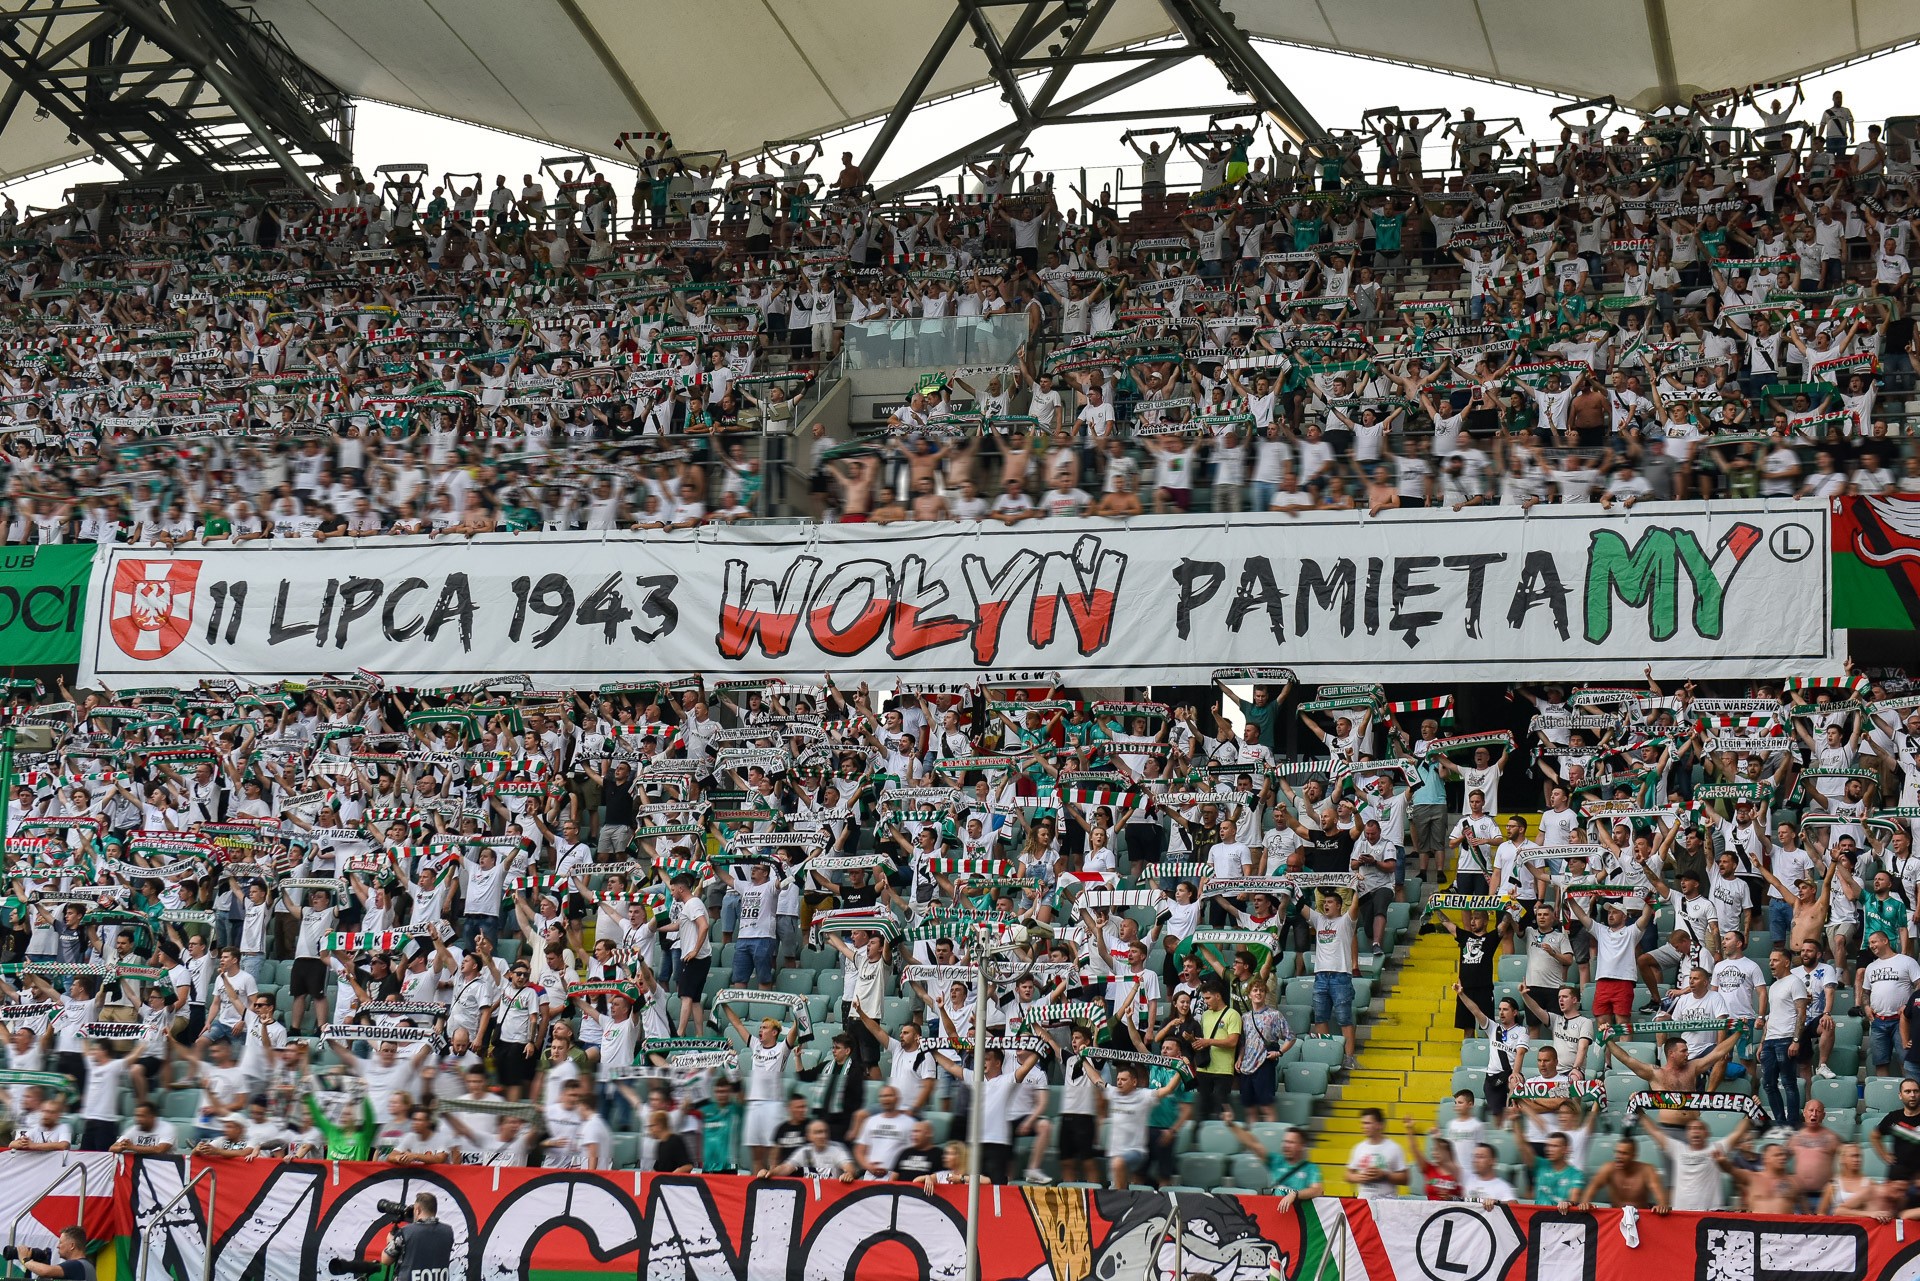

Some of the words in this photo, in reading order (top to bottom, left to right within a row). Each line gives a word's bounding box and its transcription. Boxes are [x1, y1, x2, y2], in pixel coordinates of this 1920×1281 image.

[1715, 200, 1741, 212] FANS
[1613, 240, 1650, 251] LEGIA
[979, 267, 1004, 275] FANS
[1425, 331, 1444, 340] EGIA
[1448, 325, 1494, 337] WARSZAWA
[374, 335, 412, 346] TOLICA
[1318, 341, 1367, 349] WARSZAWA
[1458, 348, 1477, 356] STRZ
[1486, 341, 1513, 352] POLSKI
[1082, 359, 1117, 368] WARSZAWA
[1819, 355, 1871, 371] NATOLIN
[1510, 363, 1551, 377] AMPIONS
[689, 373, 707, 383] KS
[2, 556, 36, 570] UB
[204, 580, 248, 646] 11
[267, 572, 481, 654] LIPCA
[507, 570, 679, 649] 1943
[715, 534, 1130, 666] WOŁYŃ
[907, 684, 962, 693] ŁUKÓW
[1319, 687, 1338, 695] LEGIA
[1729, 702, 1780, 710] WARSZAWA
[1104, 744, 1162, 753] ZIELONKA
[1720, 739, 1740, 747] LEGIA
[811, 745, 837, 754] DIVIDED
[431, 753, 452, 762] FANS
[1351, 762, 1364, 770] EGIA
[1367, 759, 1399, 768] WARSZAWA
[642, 774, 682, 783] LEGIA
[1828, 768, 1877, 779] WARSZAWA
[499, 783, 543, 794] LEGIA
[1196, 792, 1247, 804] WARSZAWA
[902, 811, 937, 821] LEGIA
[740, 834, 754, 845] NIE
[759, 833, 807, 844] PODDAWAJ
[5, 838, 45, 853] LEGIA
[1520, 850, 1542, 859] LEGIA
[1207, 882, 1240, 891] LUCJAN
[1445, 895, 1465, 907] DEN
[1470, 895, 1501, 907] HAAG
[1633, 1022, 1662, 1032] LEGIA
[1665, 1020, 1725, 1030] WARSZAWA
[331, 1027, 351, 1037] NIE
[357, 1027, 424, 1039] PODDAWAJ
[919, 1037, 950, 1053] EGIA
[1514, 1082, 1547, 1096] CNO
[1691, 1093, 1765, 1120] ZAGŁĘBIE
[411, 1269, 448, 1281] FOTO
